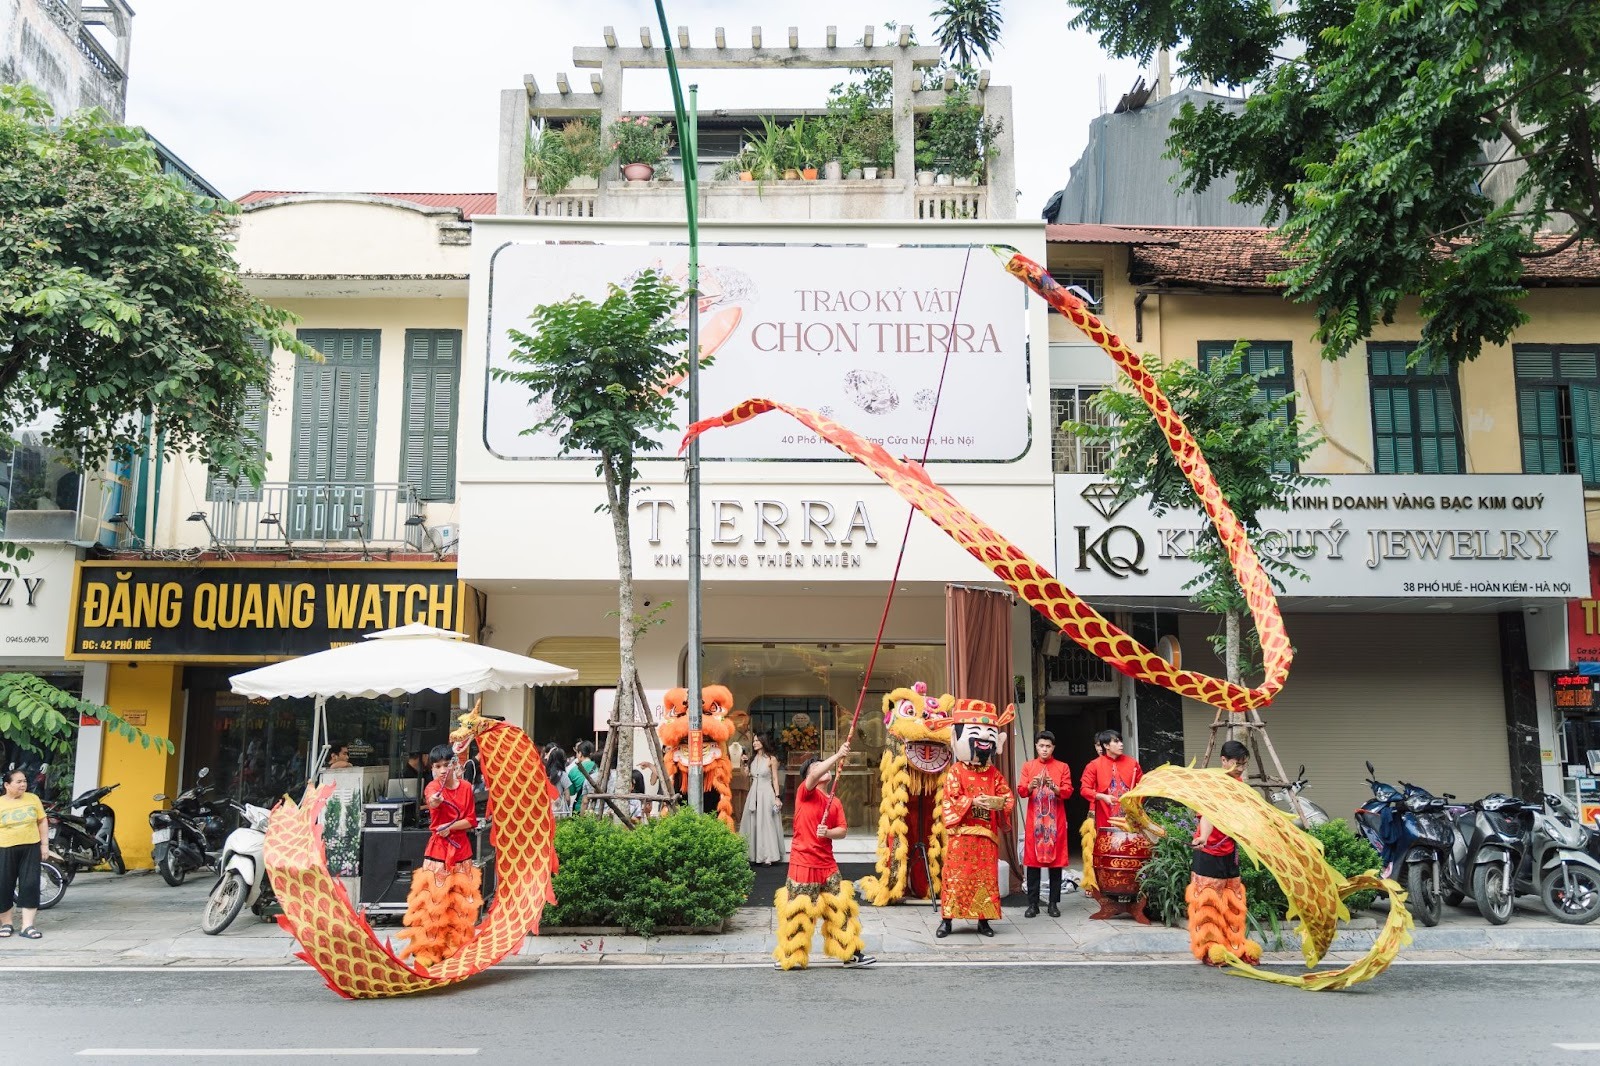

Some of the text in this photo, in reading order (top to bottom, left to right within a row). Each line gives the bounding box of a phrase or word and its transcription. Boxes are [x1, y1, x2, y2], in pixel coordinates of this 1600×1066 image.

[794, 287, 958, 314] TRAO KỶ VẬT
[751, 322, 1002, 356] CHỌN TIERRA
[781, 436, 794, 444] 40
[797, 435, 817, 444] Phố
[887, 436, 908, 445] Cửa
[940, 436, 954, 445] Hà
[957, 436, 974, 447] Nội
[1292, 496, 1329, 510] KINH
[1331, 496, 1388, 510] DOANH
[1393, 493, 1435, 510] VÀNG
[1440, 496, 1473, 513] BẠC
[1478, 496, 1507, 510] KIM
[1512, 492, 1545, 511] QUÝ
[636, 499, 879, 546] TERRA
[1366, 528, 1559, 569] JEWELRY
[653, 551, 861, 568] KIM ƯƠNG THIÊN NHIÊN
[1403, 583, 1415, 592] 38
[1470, 580, 1501, 592] HOÀN
[1535, 580, 1551, 592] HÀ
[83, 571, 455, 630] ĐĂNG QUANG WATCH
[82, 637, 152, 650] ĐC: 42 PHỐ HUẾ
[1071, 683, 1086, 693] 38
